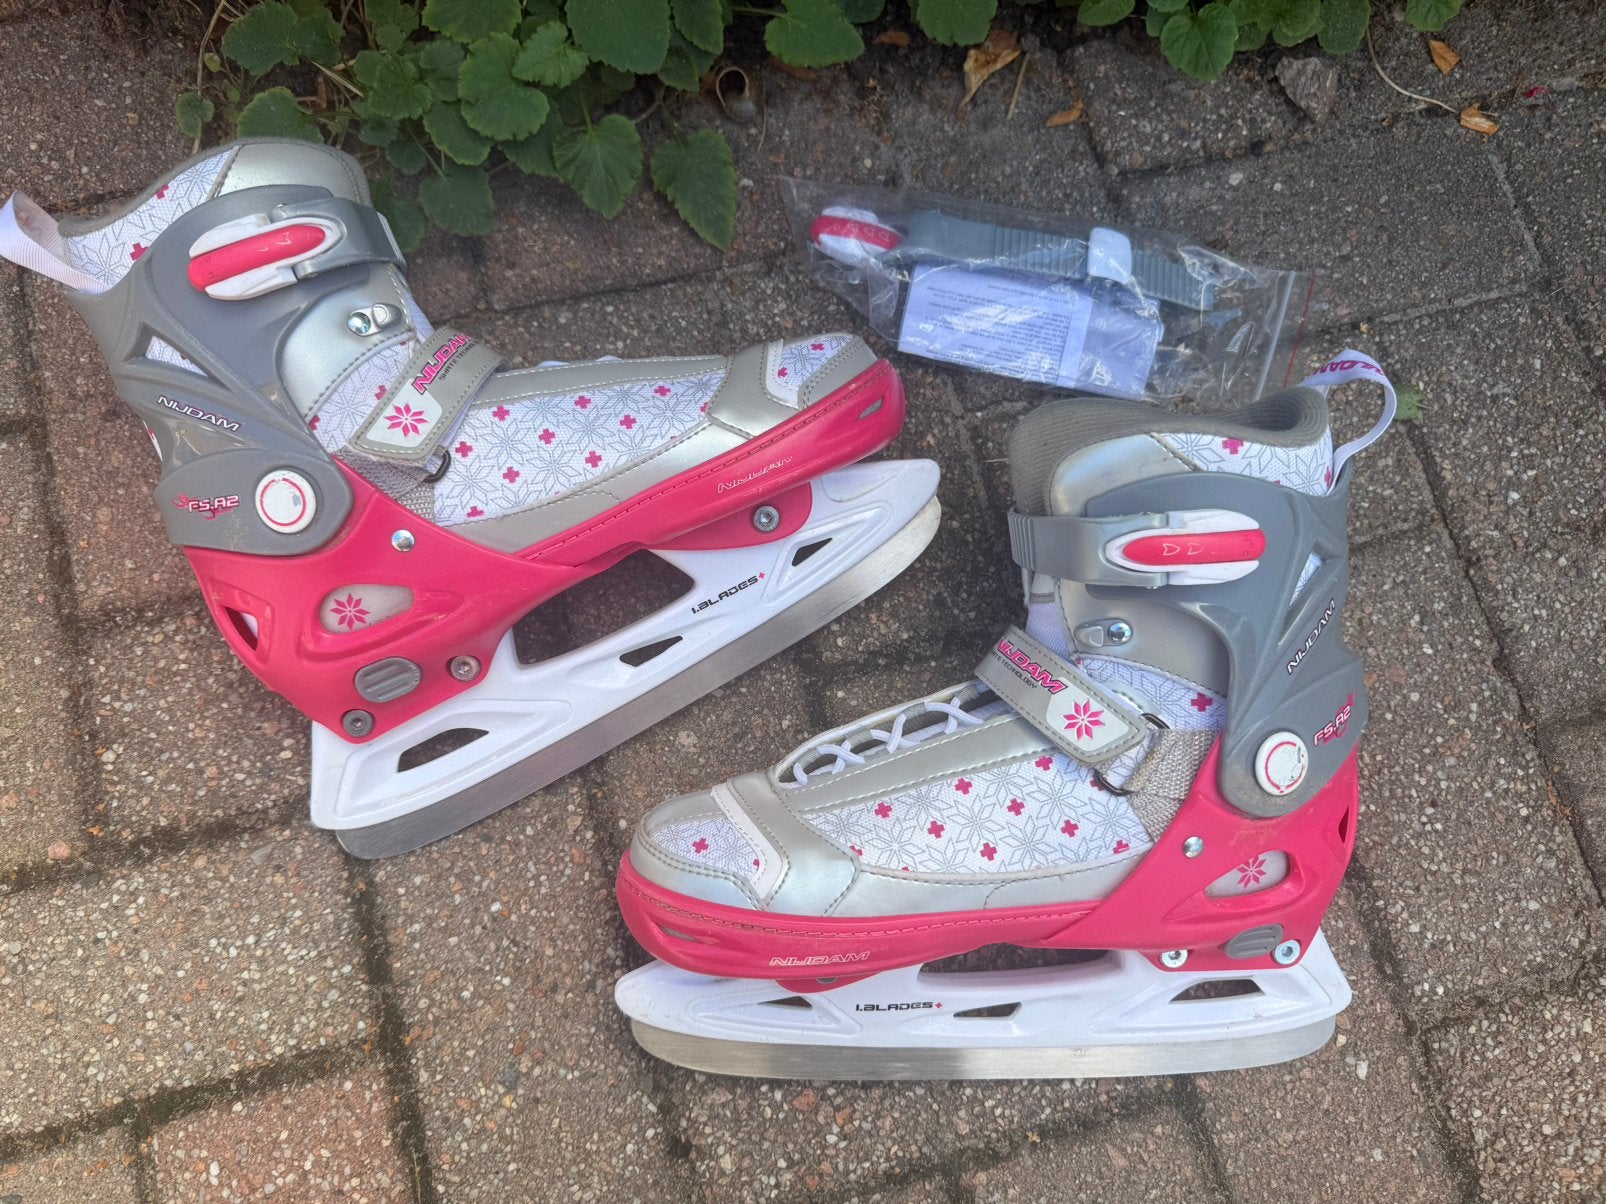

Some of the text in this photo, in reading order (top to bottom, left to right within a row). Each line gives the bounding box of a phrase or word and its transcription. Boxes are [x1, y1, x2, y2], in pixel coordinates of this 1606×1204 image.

[157, 395, 242, 433] NIJDAM
[187, 494, 240, 513] FS.A2
[1286, 599, 1336, 675] NIJDAM
[1000, 659, 1038, 689] TECHNOLOGY
[1313, 704, 1351, 747] FS.A2
[769, 951, 871, 966] NIJDAM
